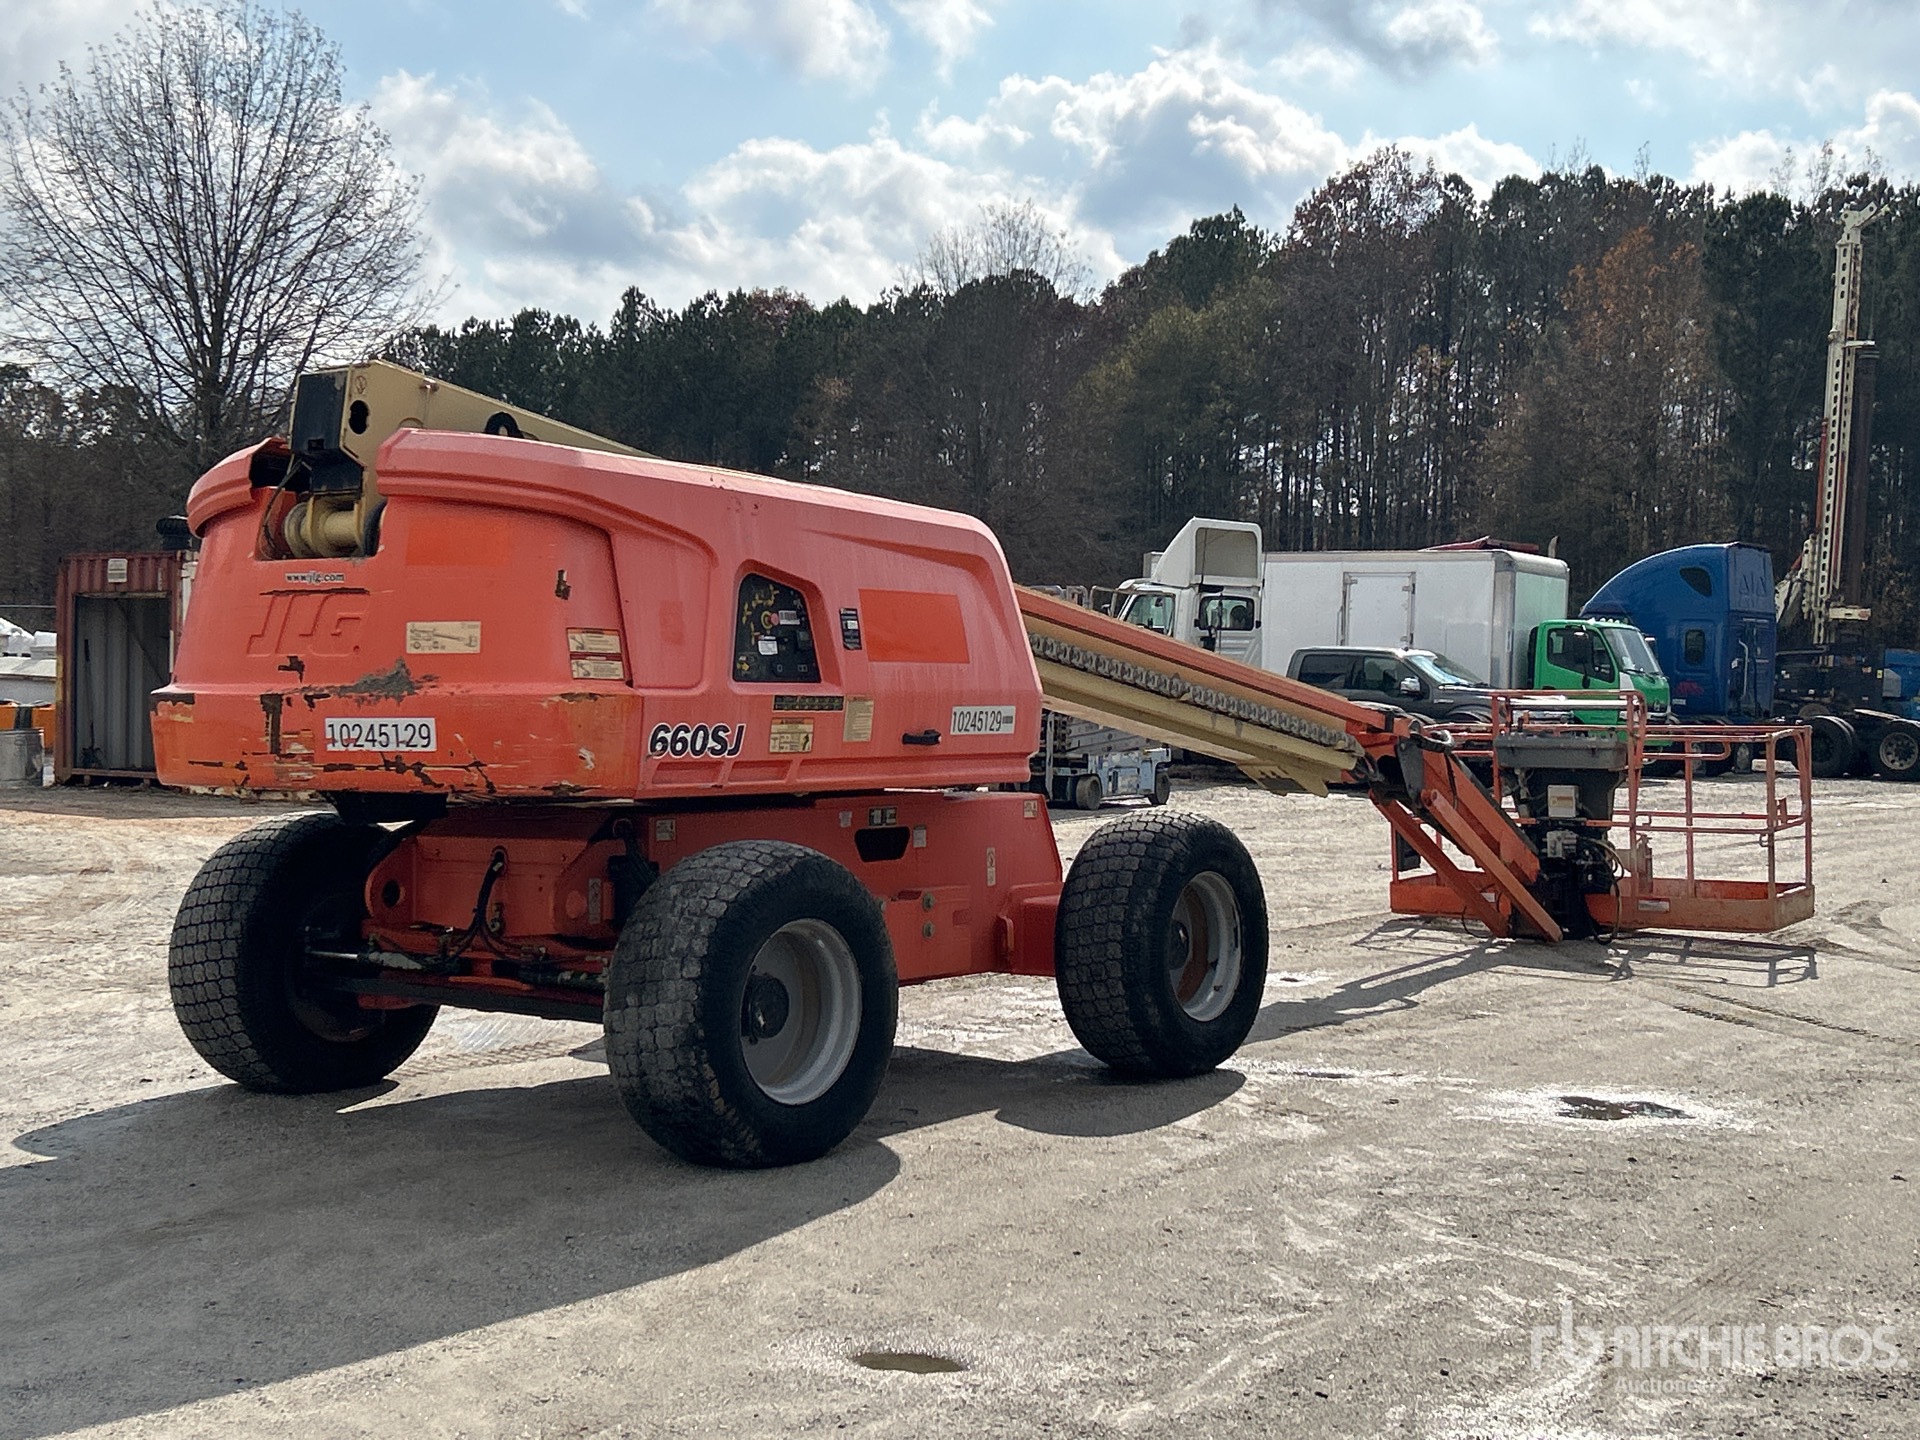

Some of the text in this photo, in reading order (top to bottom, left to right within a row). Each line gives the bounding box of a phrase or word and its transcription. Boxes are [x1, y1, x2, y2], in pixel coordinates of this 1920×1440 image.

[286, 571, 344, 584] www.jlg.com
[952, 710, 1002, 732] 10245129
[327, 723, 432, 748] 10245129
[649, 722, 747, 759] 660SJ
